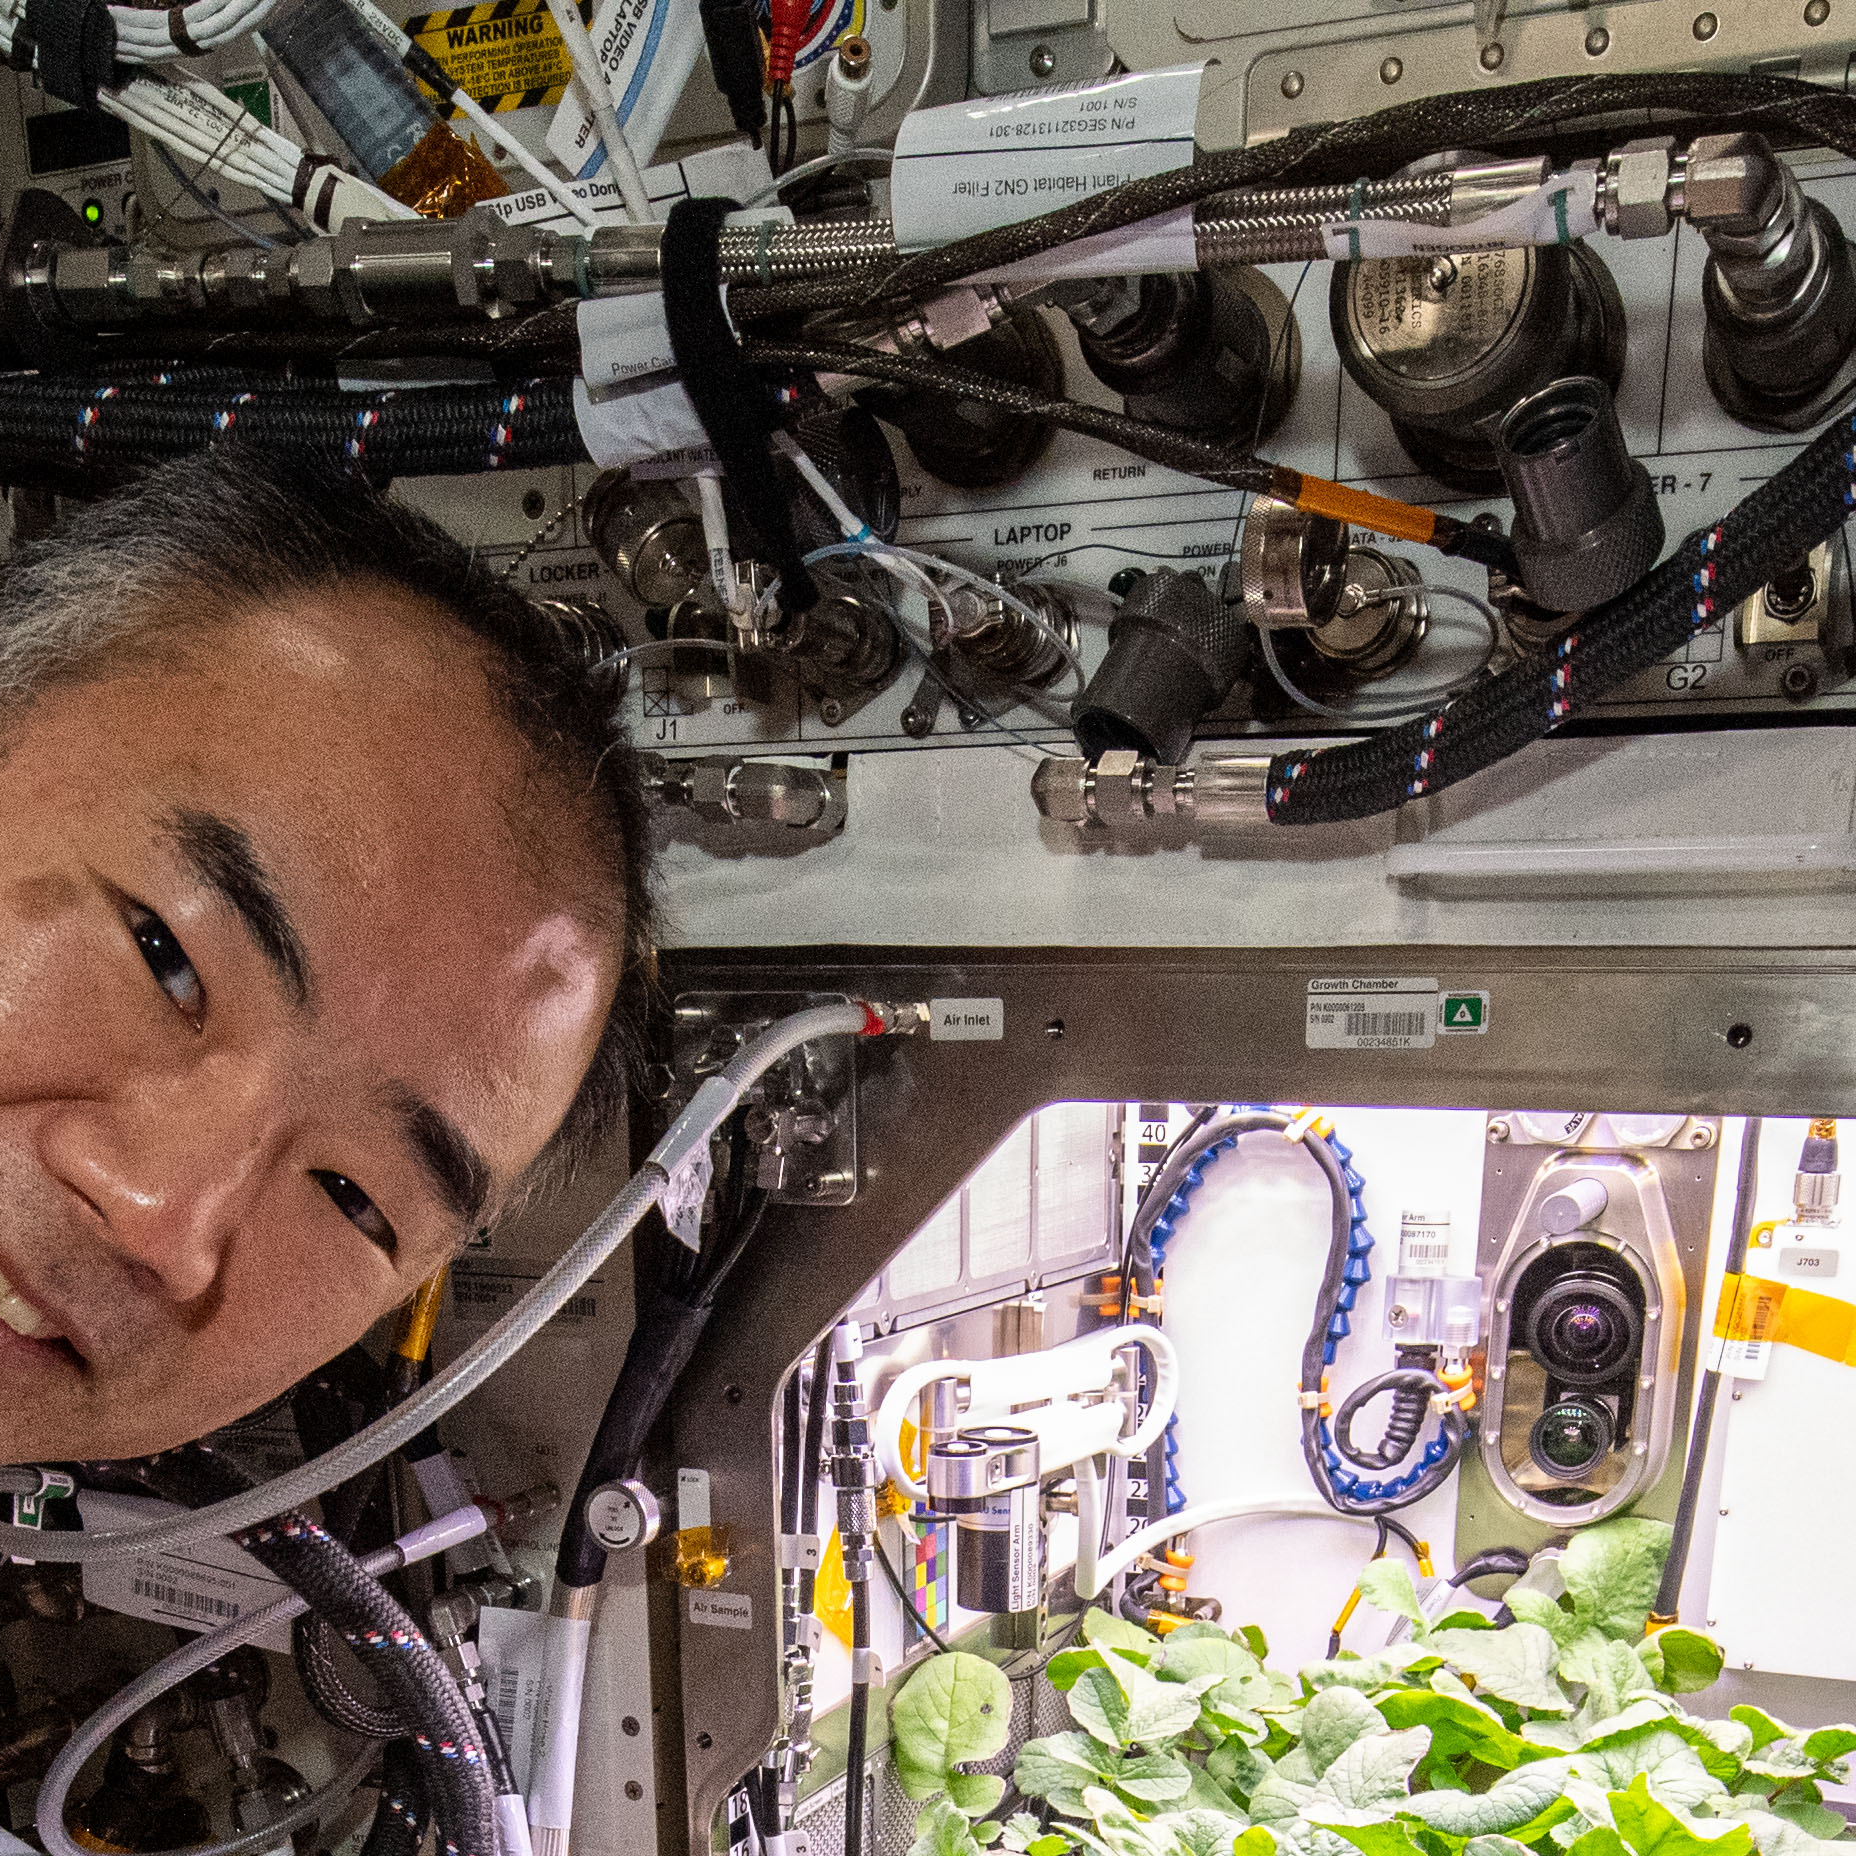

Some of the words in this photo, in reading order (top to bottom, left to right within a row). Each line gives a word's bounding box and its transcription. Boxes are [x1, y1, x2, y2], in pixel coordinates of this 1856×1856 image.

[446, 14, 544, 49] WARNING
[1079, 99, 1109, 112] 1001
[1113, 96, 1139, 110] S/N
[988, 119, 1108, 138] SEG32113128-301
[1110, 117, 1136, 131] P/N
[952, 180, 991, 197] Filter
[994, 178, 1030, 196] GN2
[1032, 175, 1088, 192] Habitat
[515, 192, 547, 214] USB
[610, 360, 646, 377] Power
[1093, 464, 1147, 481] RETURN
[1700, 473, 1712, 492] 7
[994, 523, 1072, 546] LAPTOP
[1182, 541, 1232, 558] POWER
[528, 563, 601, 584] LOCKER
[1764, 648, 1795, 662] OFF
[1666, 664, 1707, 690] G2
[1311, 980, 1350, 991] Growth
[1352, 979, 1400, 991] Chamber
[944, 1013, 962, 1027] Air
[964, 1013, 991, 1027] Inlet
[1141, 1123, 1167, 1144] 40
[1796, 1257, 1821, 1268] J703
[1011, 1524, 1021, 1547] Arm
[1011, 1548, 1021, 1586] Sensor
[1011, 1588, 1023, 1611] Light
[693, 1601, 708, 1613] Air
[710, 1602, 750, 1618] Sample
[730, 1788, 748, 1815] 18
